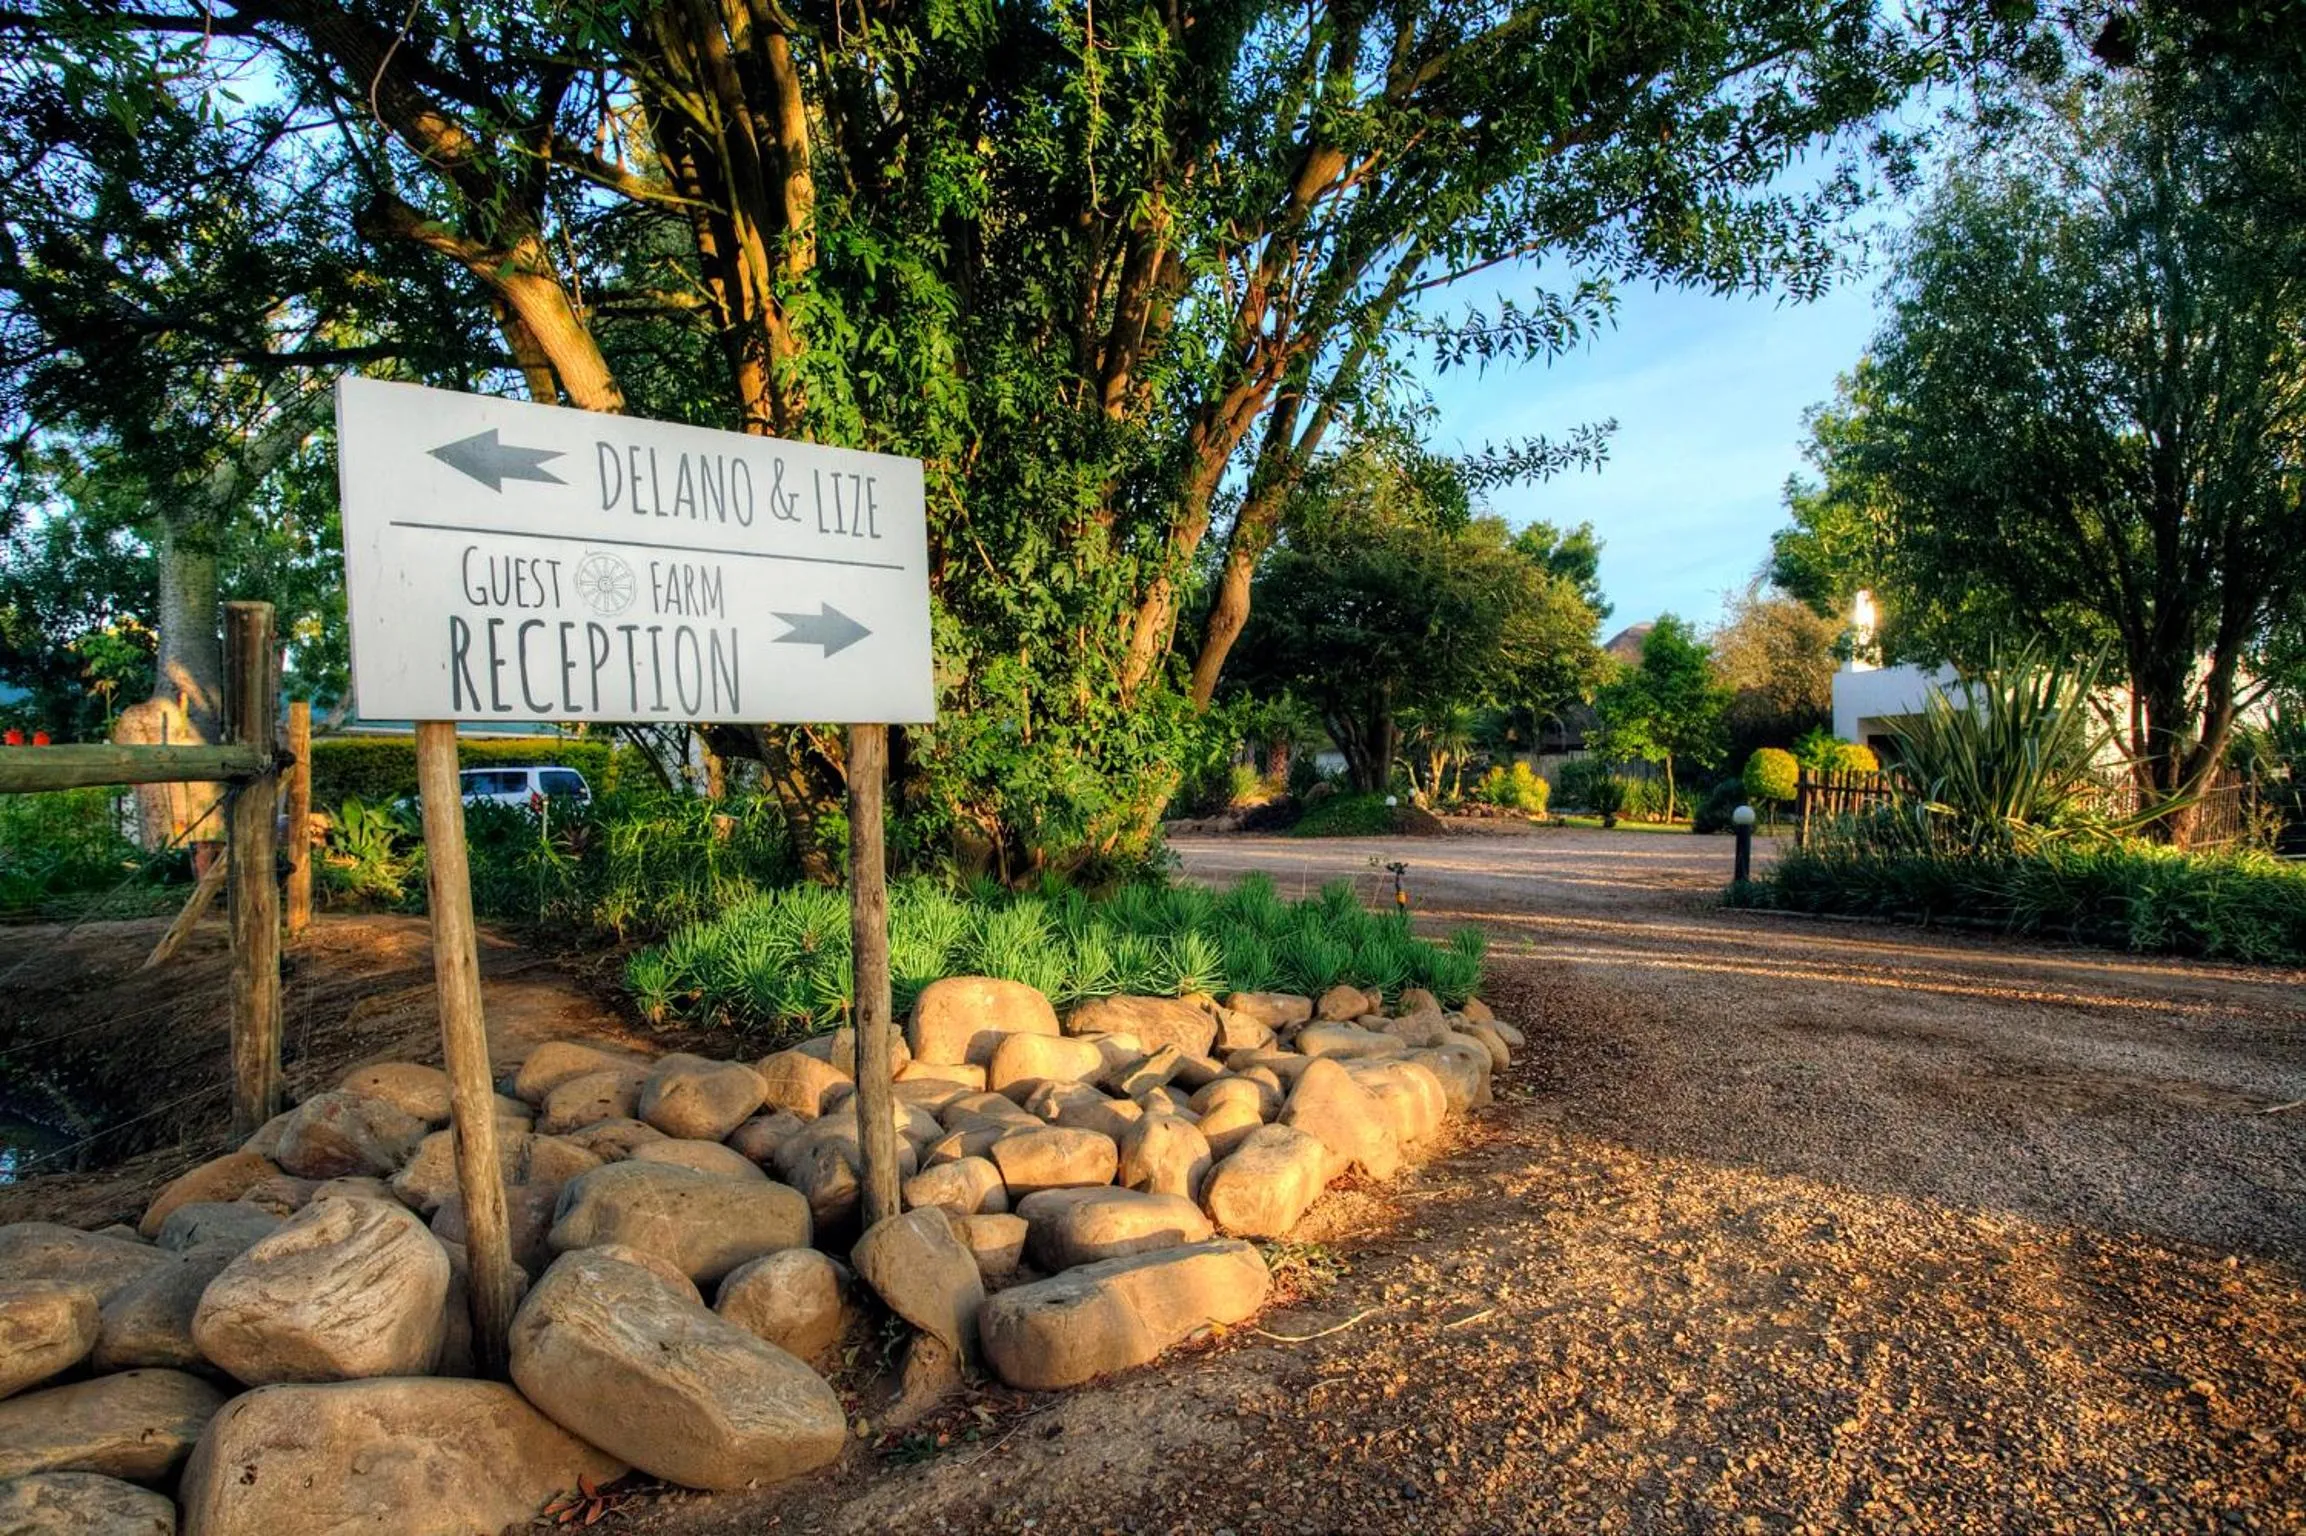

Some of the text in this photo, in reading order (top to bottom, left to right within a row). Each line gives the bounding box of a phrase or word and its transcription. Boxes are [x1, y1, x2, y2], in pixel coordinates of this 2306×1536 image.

[597, 441, 882, 539] DELANO & LIZE
[462, 545, 724, 618] GUEST FARM
[449, 615, 740, 716] RECEPTION
